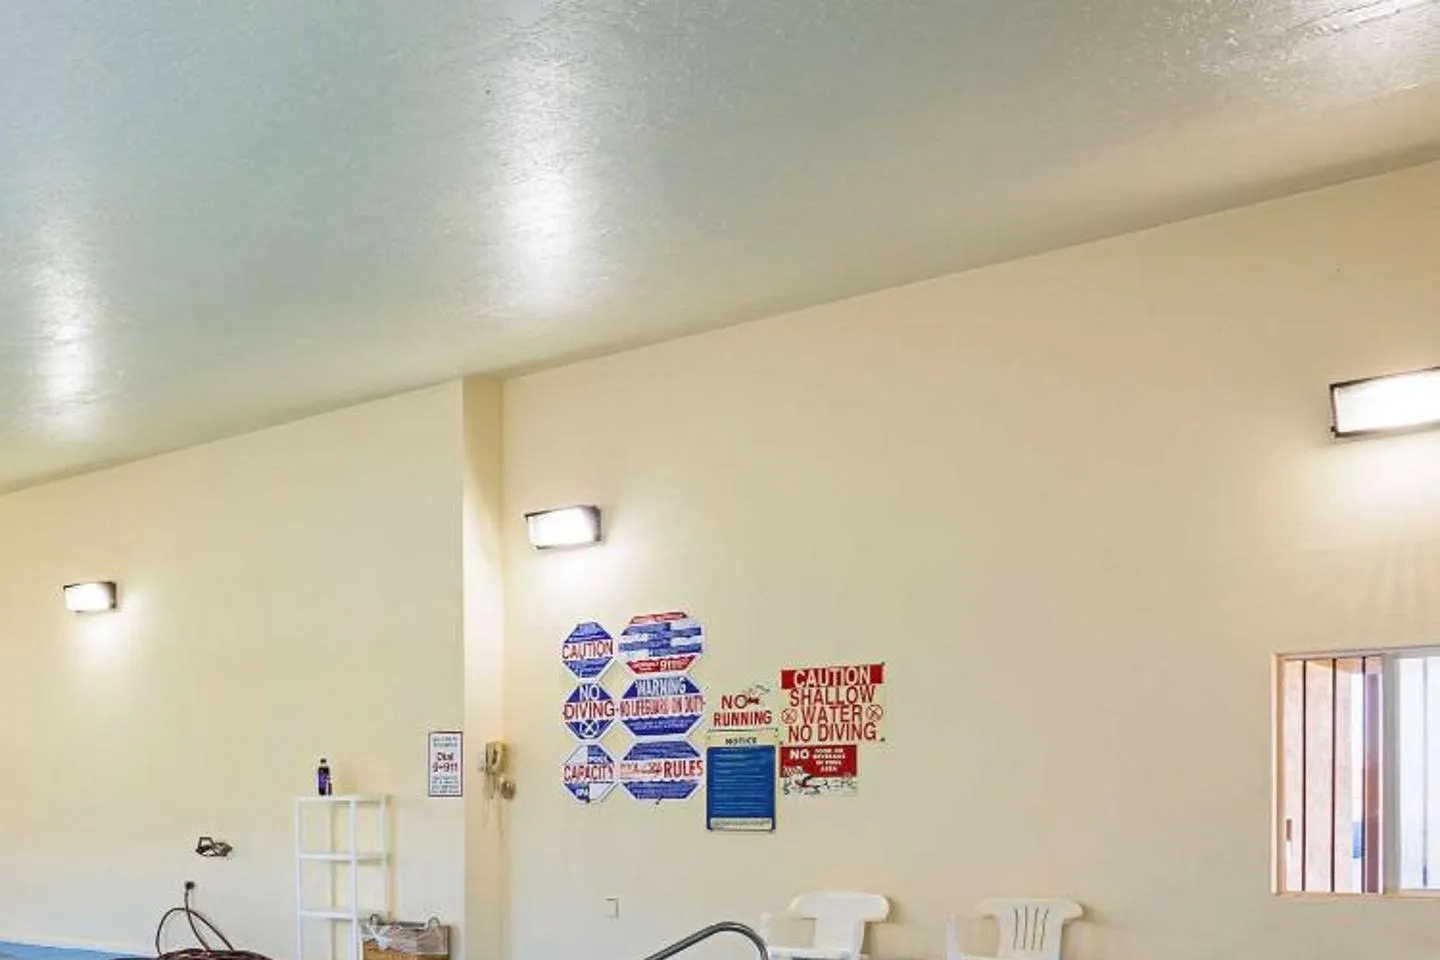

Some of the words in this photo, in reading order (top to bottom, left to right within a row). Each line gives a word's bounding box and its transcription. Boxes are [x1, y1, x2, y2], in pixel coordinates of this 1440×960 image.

[562, 641, 613, 659] CAUTION
[793, 667, 871, 688] CAUTION
[579, 683, 600, 701] NO
[635, 677, 687, 697] WARNING
[790, 685, 876, 707] SHALLOW
[564, 700, 615, 720] DIVING
[721, 694, 747, 709] NO
[713, 711, 773, 727] RUNNING
[801, 704, 863, 724] WATER
[725, 737, 757, 745] NOTICE
[788, 725, 812, 743] NO
[817, 722, 877, 742] DIVING
[789, 749, 809, 760] NO
[564, 765, 614, 781] CAPACITY
[664, 760, 704, 778] RULES
